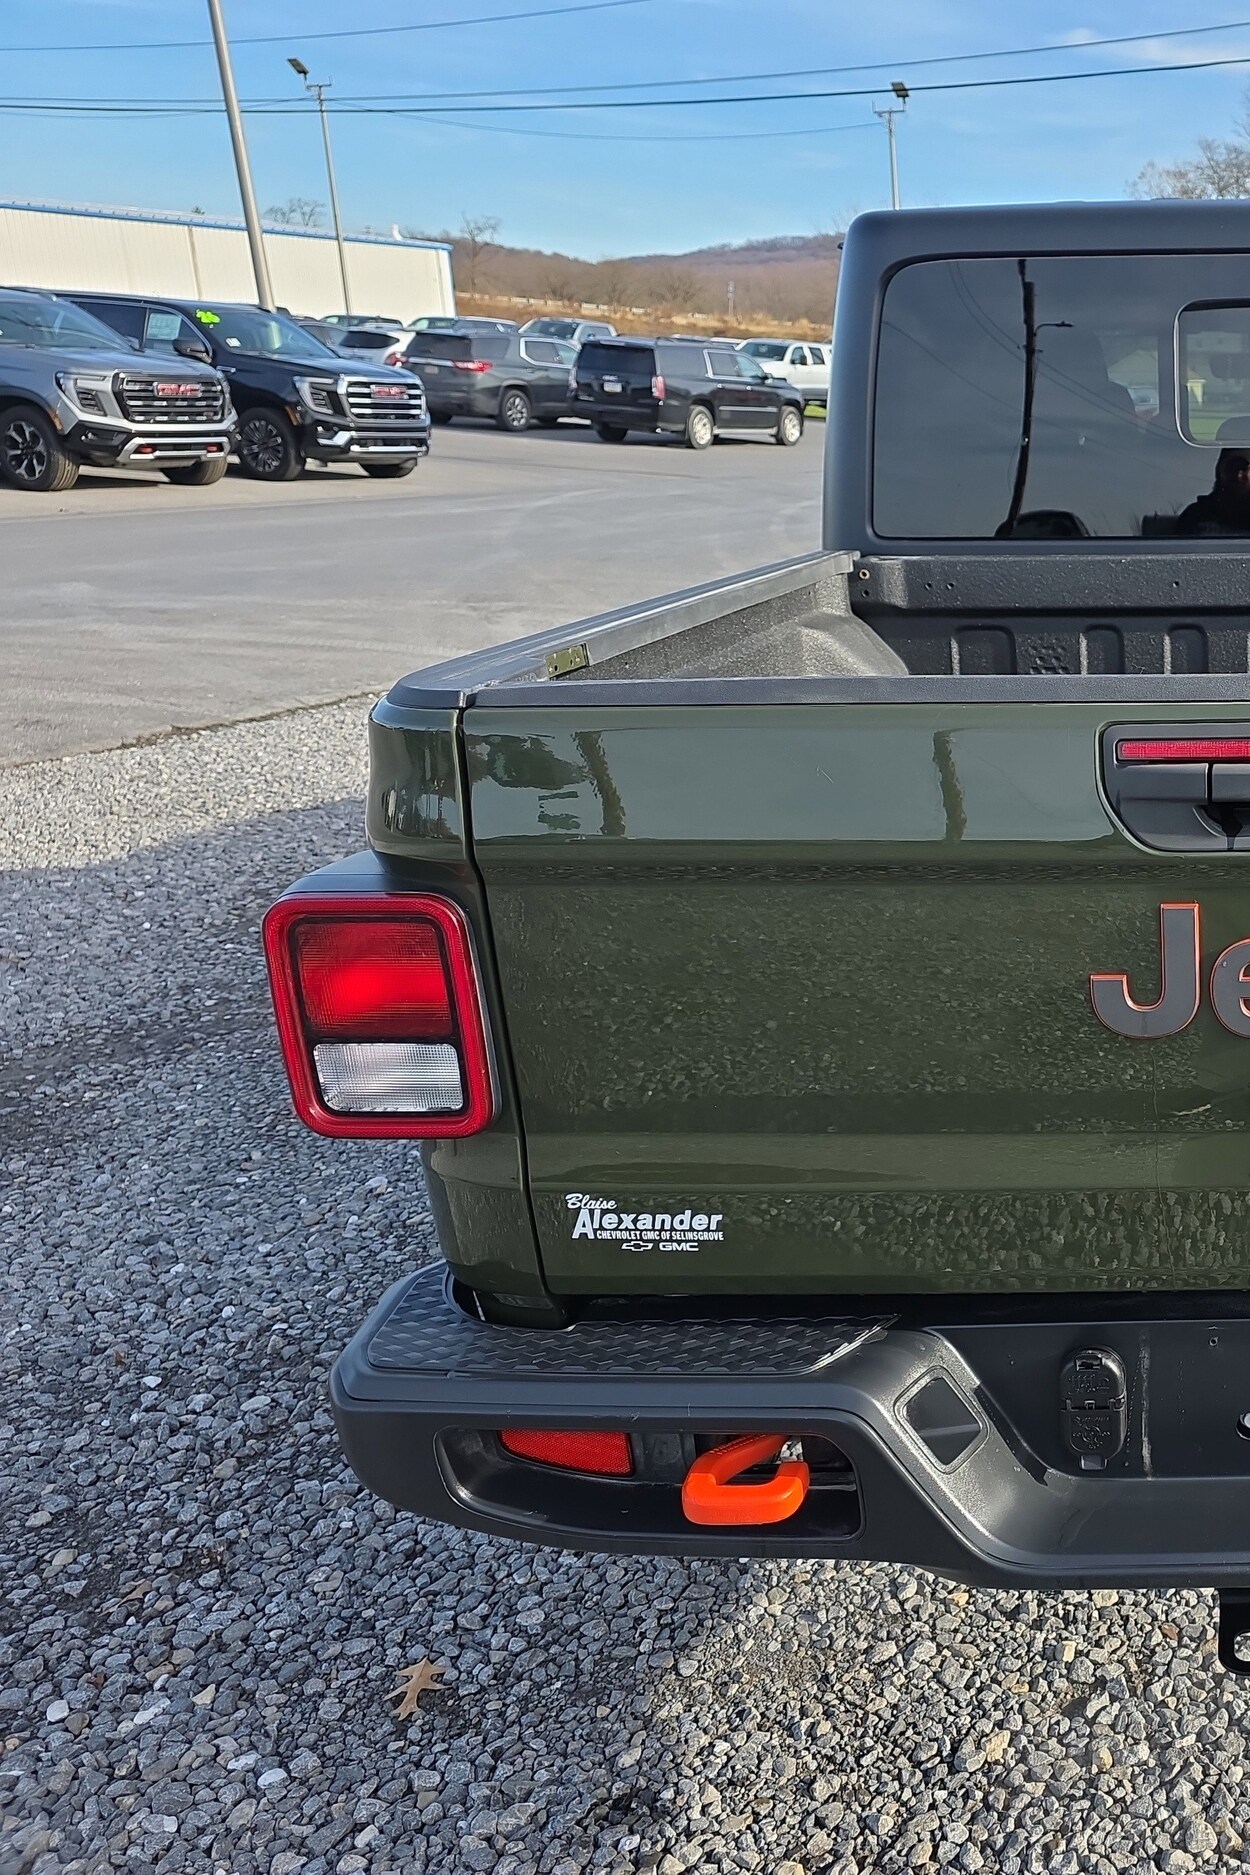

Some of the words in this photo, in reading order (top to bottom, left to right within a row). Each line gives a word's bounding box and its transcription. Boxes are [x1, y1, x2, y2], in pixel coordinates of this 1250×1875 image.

[565, 1193, 617, 1209] Blaise
[572, 1208, 723, 1239] Alexander
[597, 1230, 640, 1240] CHEVROLET
[642, 1230, 660, 1240] GMC
[661, 1231, 671, 1240] OF
[672, 1231, 724, 1241] SELINSGROVE
[659, 1242, 700, 1251] GMC
